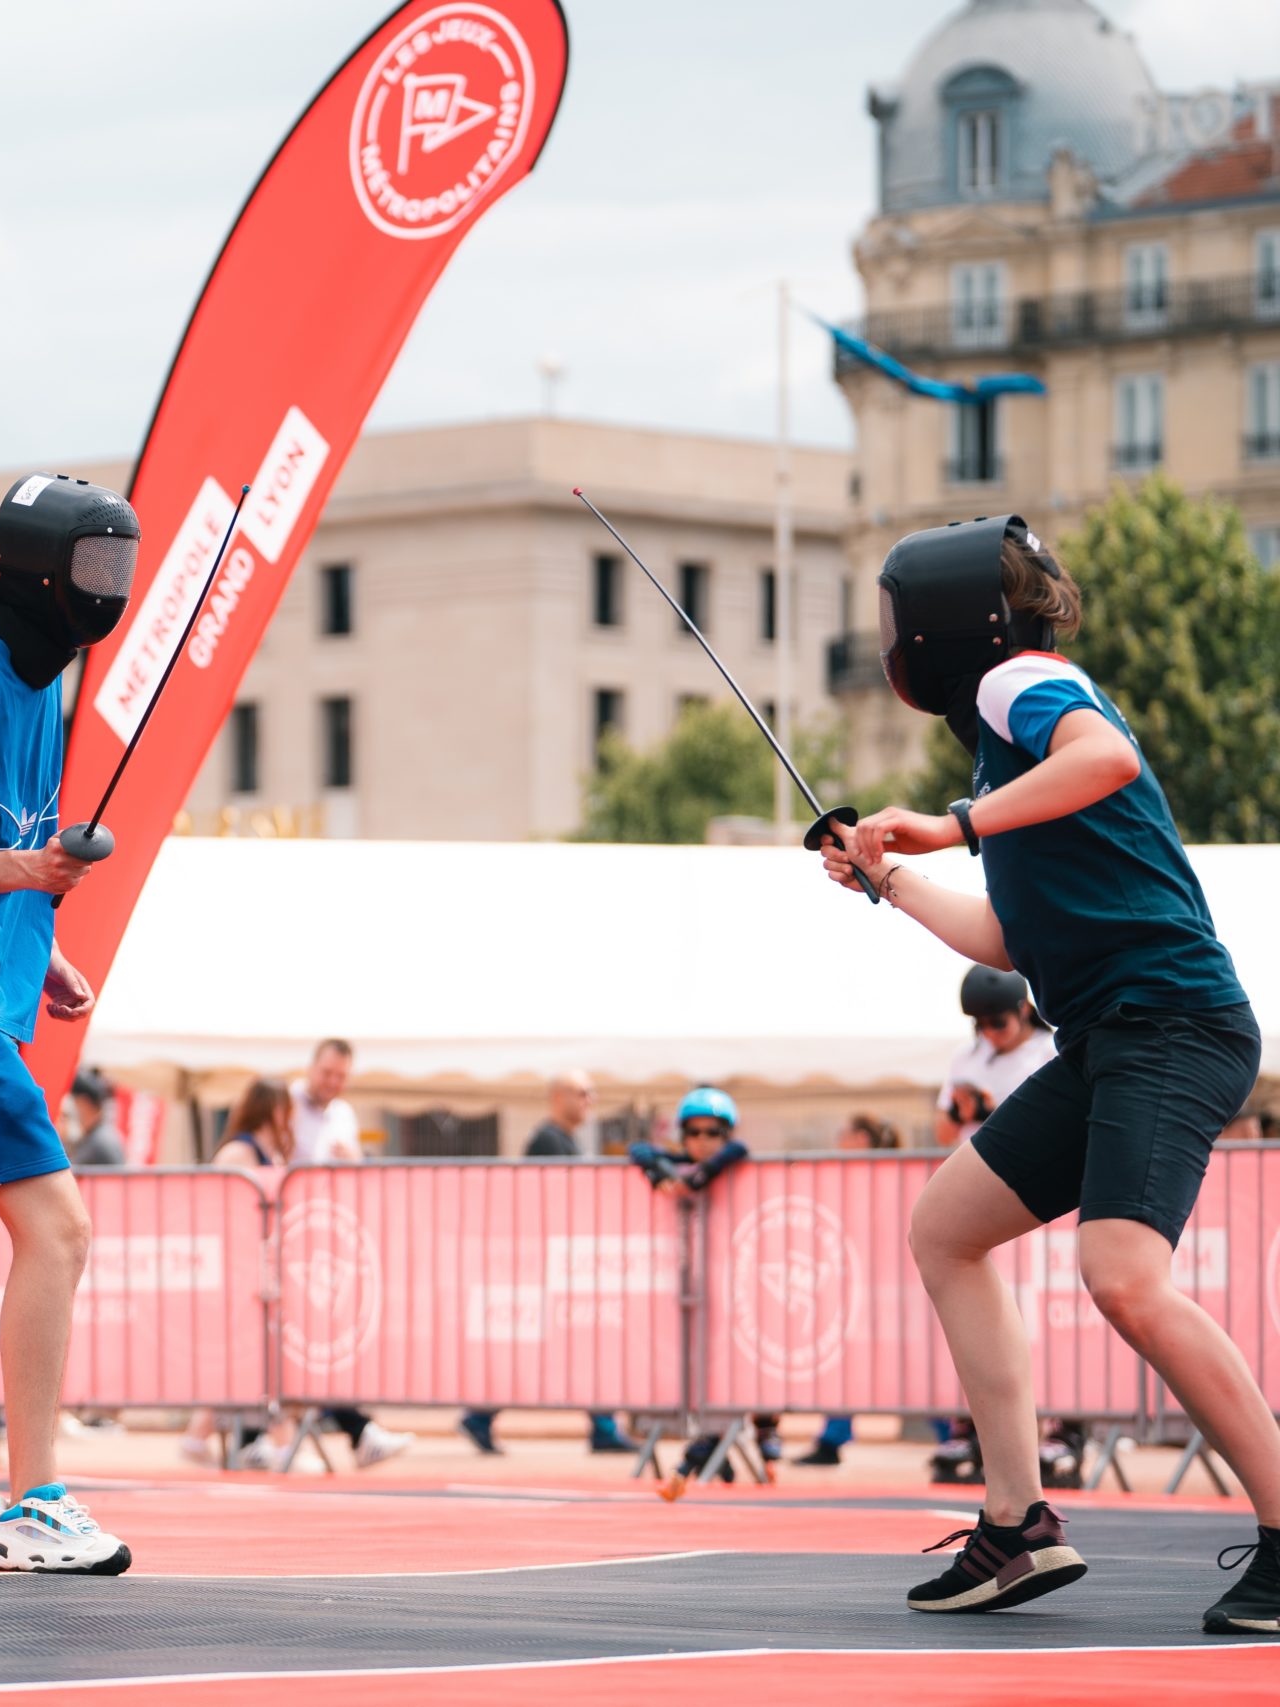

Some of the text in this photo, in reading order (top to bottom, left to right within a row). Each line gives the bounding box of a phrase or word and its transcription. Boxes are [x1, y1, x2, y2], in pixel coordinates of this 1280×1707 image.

[382, 18, 498, 84] LES JEUX
[187, 439, 308, 669] GRAND LYON
